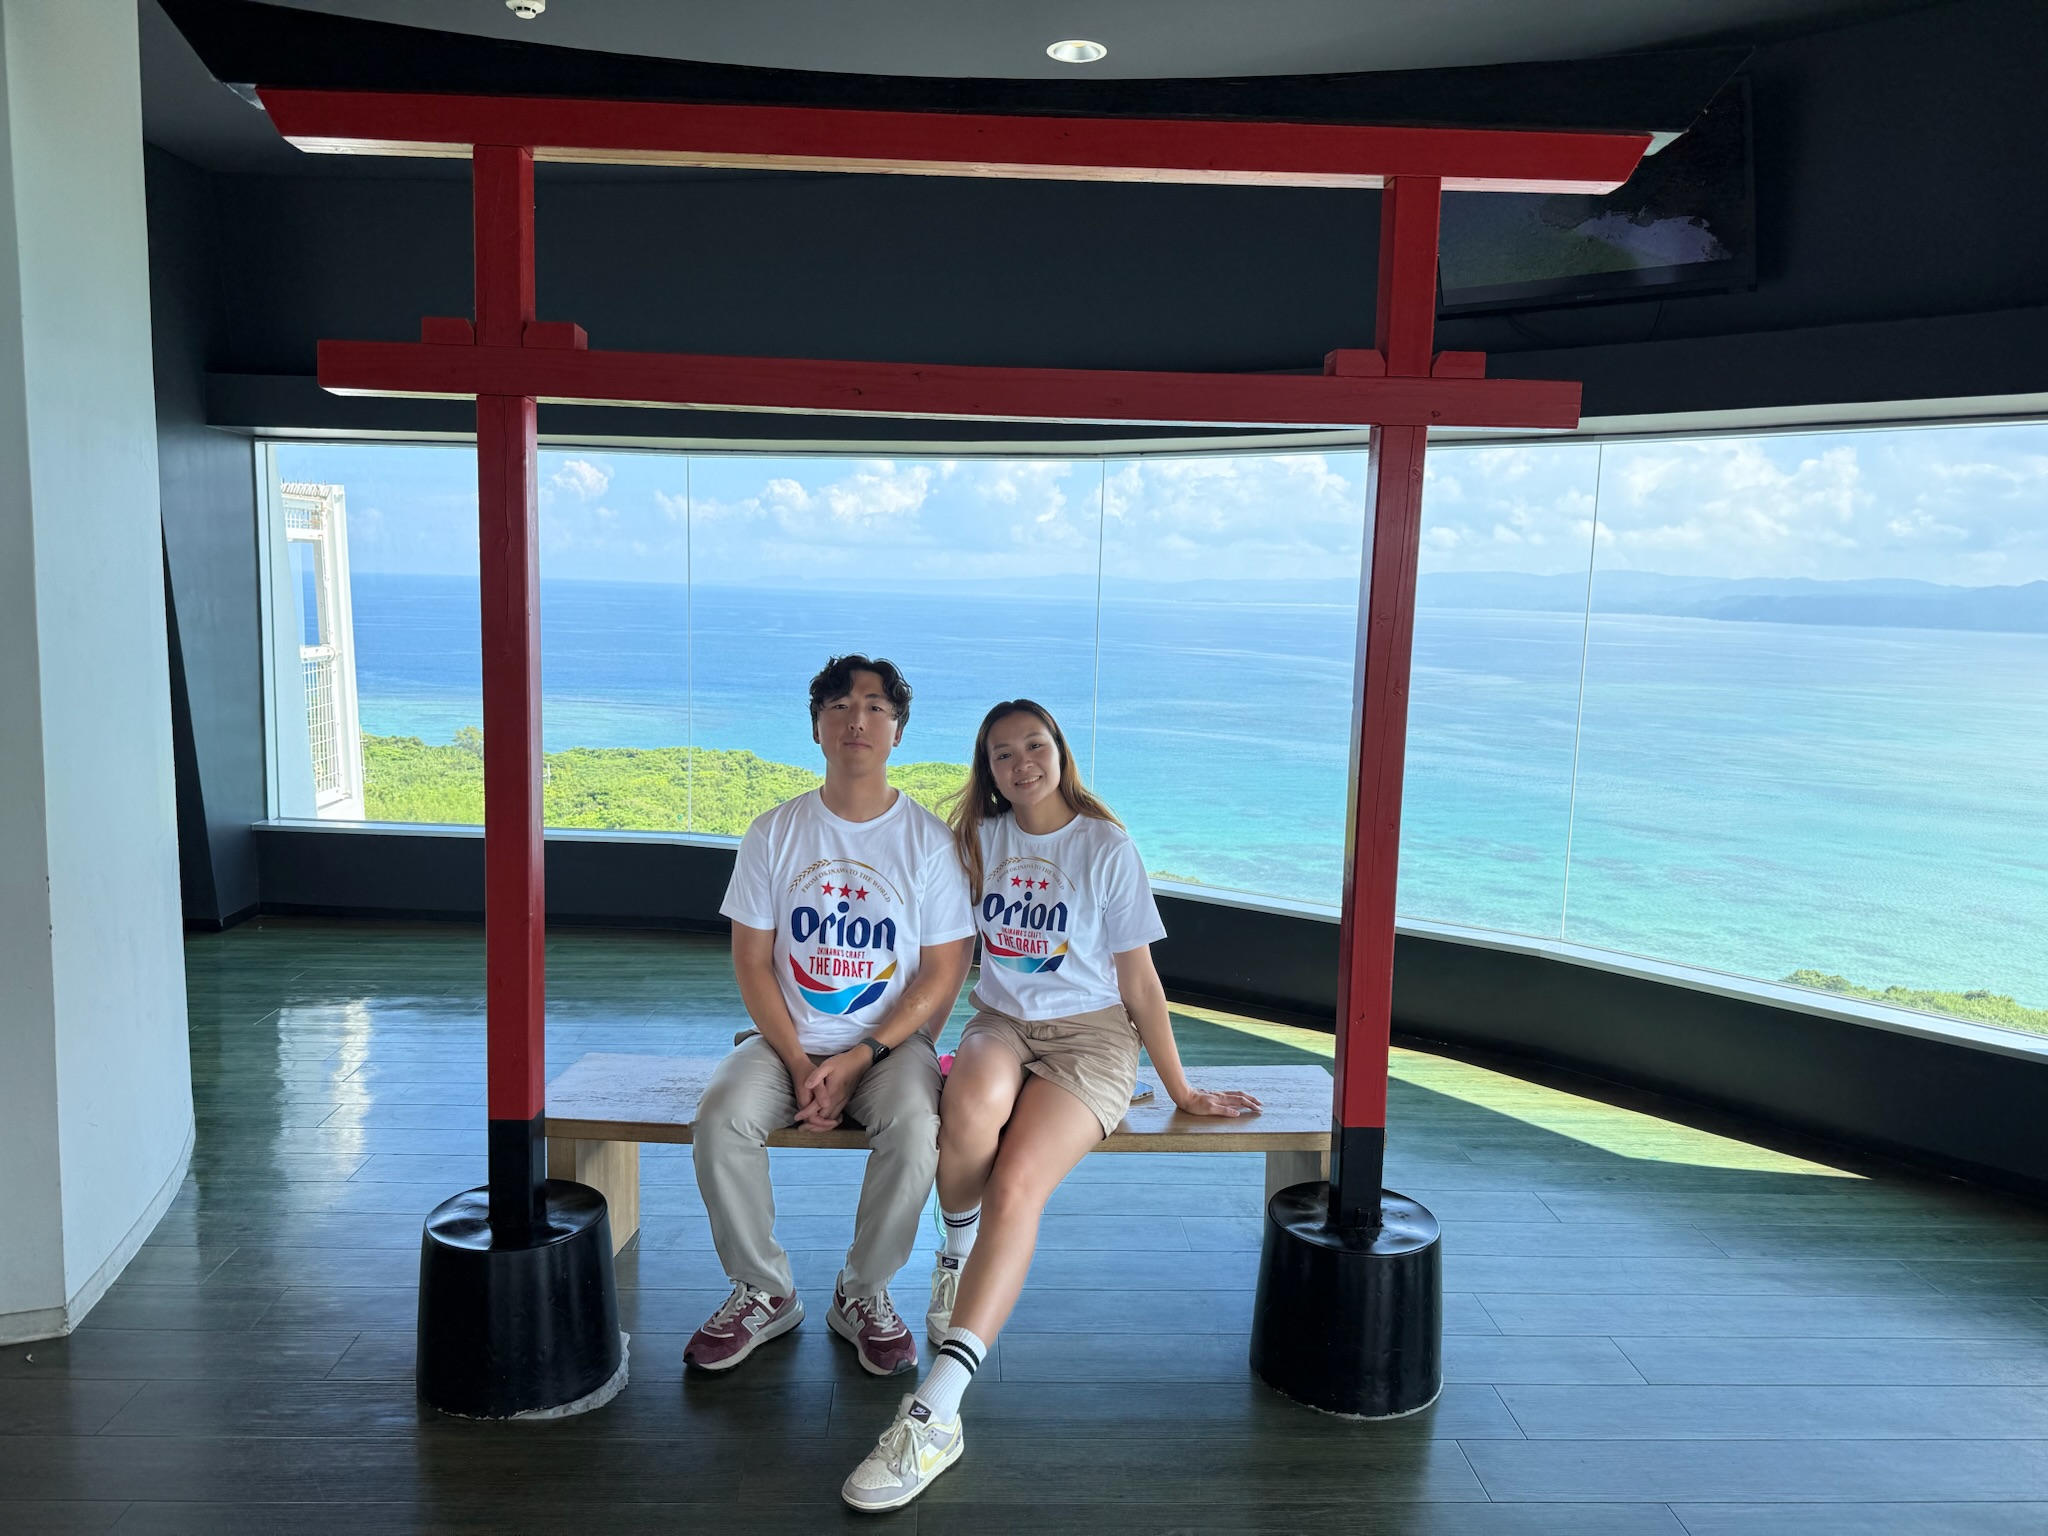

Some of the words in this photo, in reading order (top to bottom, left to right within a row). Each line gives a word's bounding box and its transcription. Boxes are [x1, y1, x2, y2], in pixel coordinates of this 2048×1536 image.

[801, 875, 819, 893] FROM
[848, 868, 858, 876] TO
[859, 871, 872, 883] THE
[872, 880, 891, 903] WORLD
[983, 891, 1068, 932] Orion
[791, 901, 896, 952] Orion
[845, 950, 865, 959] CRAFT
[997, 932, 1015, 948] THE
[1016, 937, 1048, 955] DRAFT
[809, 956, 829, 976] THE
[833, 959, 874, 979] DRAFT
